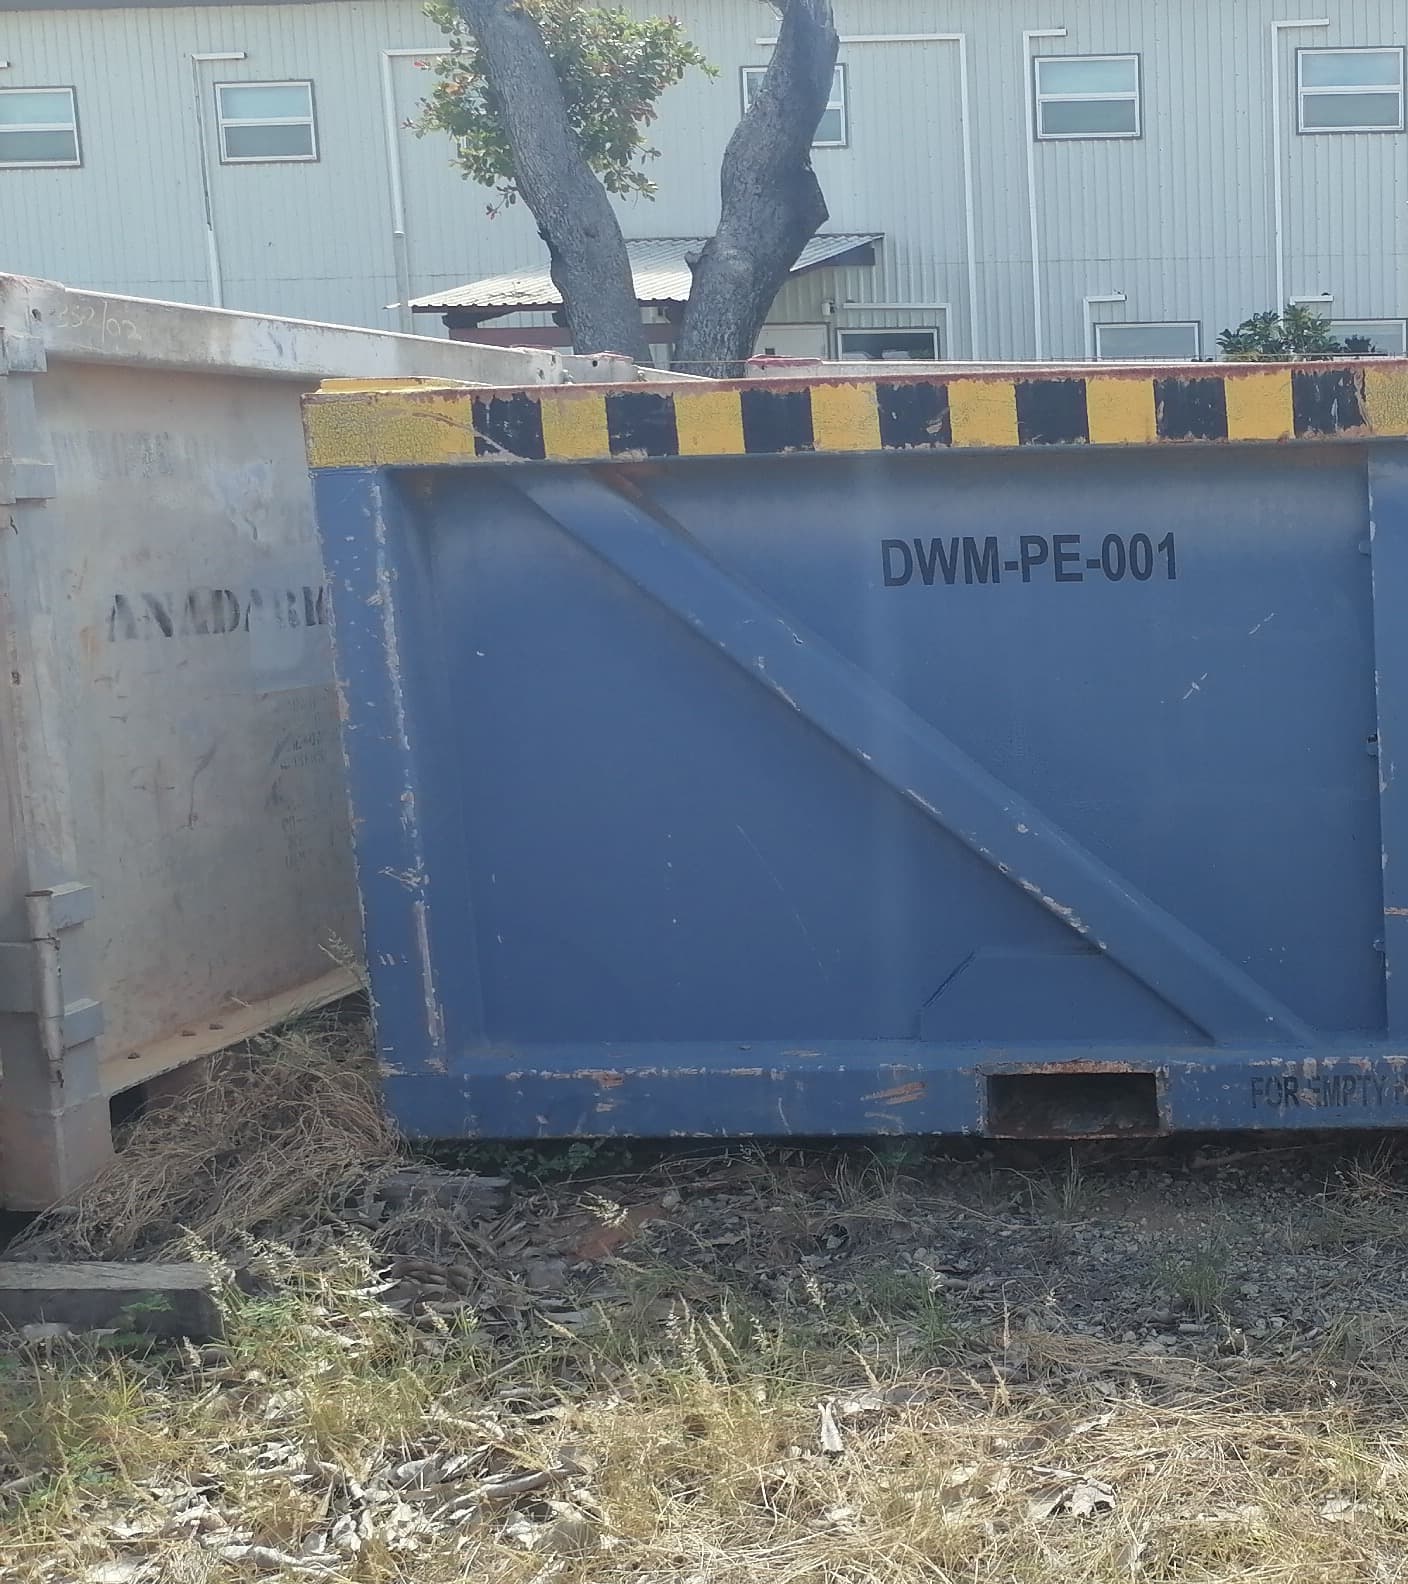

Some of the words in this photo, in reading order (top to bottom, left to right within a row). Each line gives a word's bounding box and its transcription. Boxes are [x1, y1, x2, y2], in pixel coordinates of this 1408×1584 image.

[881, 532, 1177, 587] DWM-PE-001
[1251, 1075, 1299, 1109] FOR
[1306, 1074, 1387, 1108] EMPTY
